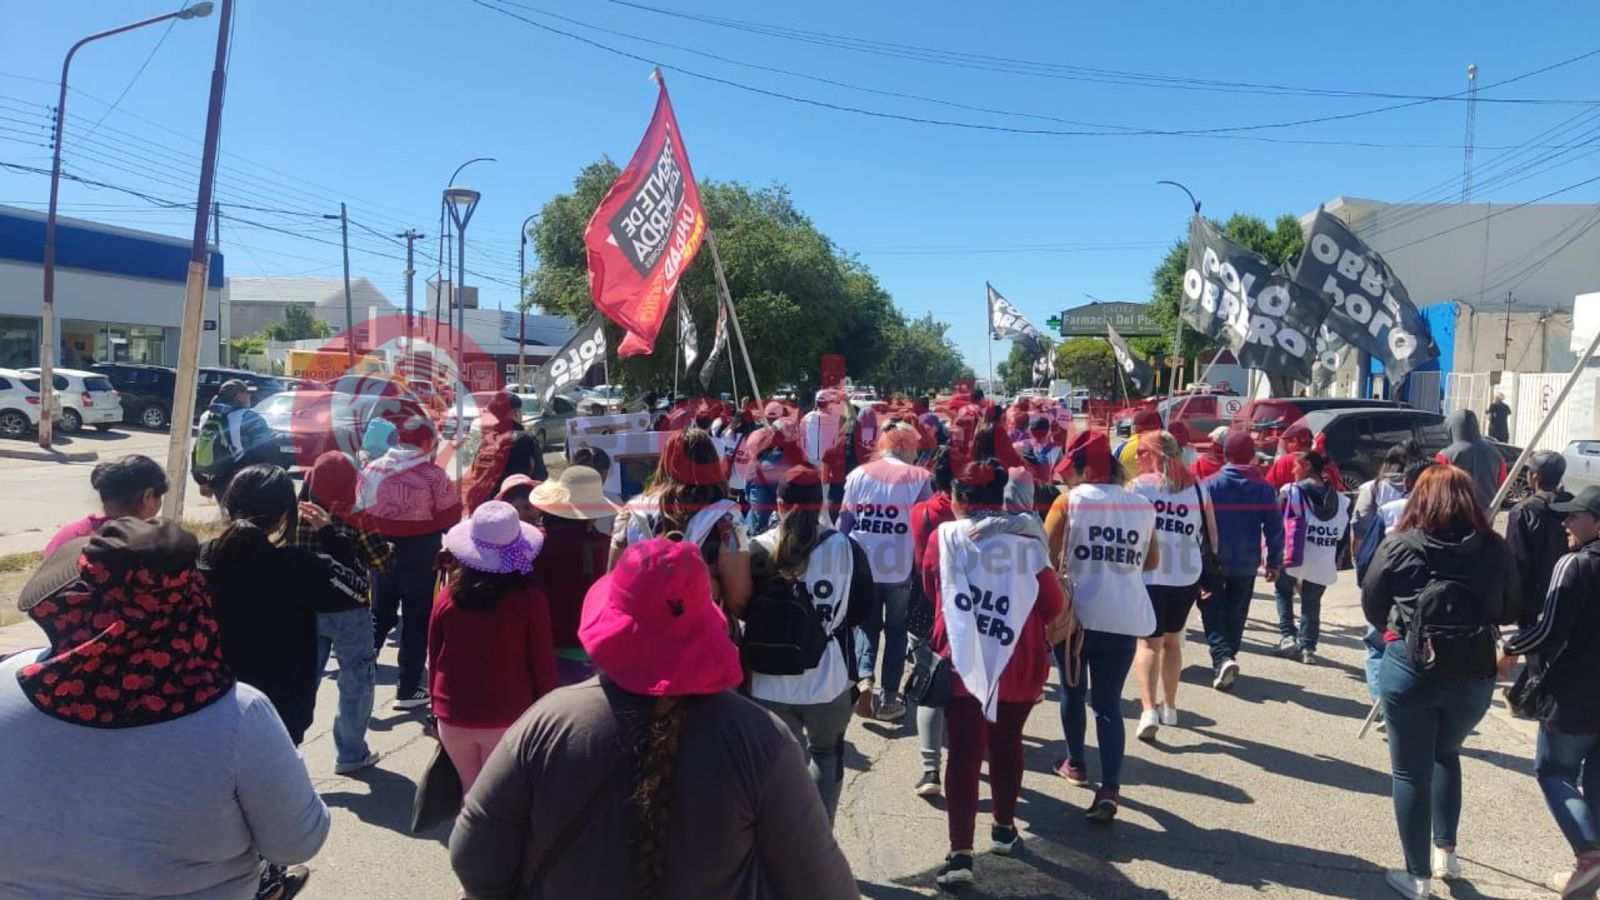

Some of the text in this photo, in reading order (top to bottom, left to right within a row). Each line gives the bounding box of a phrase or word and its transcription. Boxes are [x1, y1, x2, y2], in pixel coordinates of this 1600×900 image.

[1202, 246, 1291, 318] POLO
[1063, 314, 1113, 326] Farmacia
[1116, 314, 1134, 326] Del
[856, 504, 899, 519] POLO
[1153, 499, 1188, 518] OLO
[1089, 526, 1140, 545] POLO
